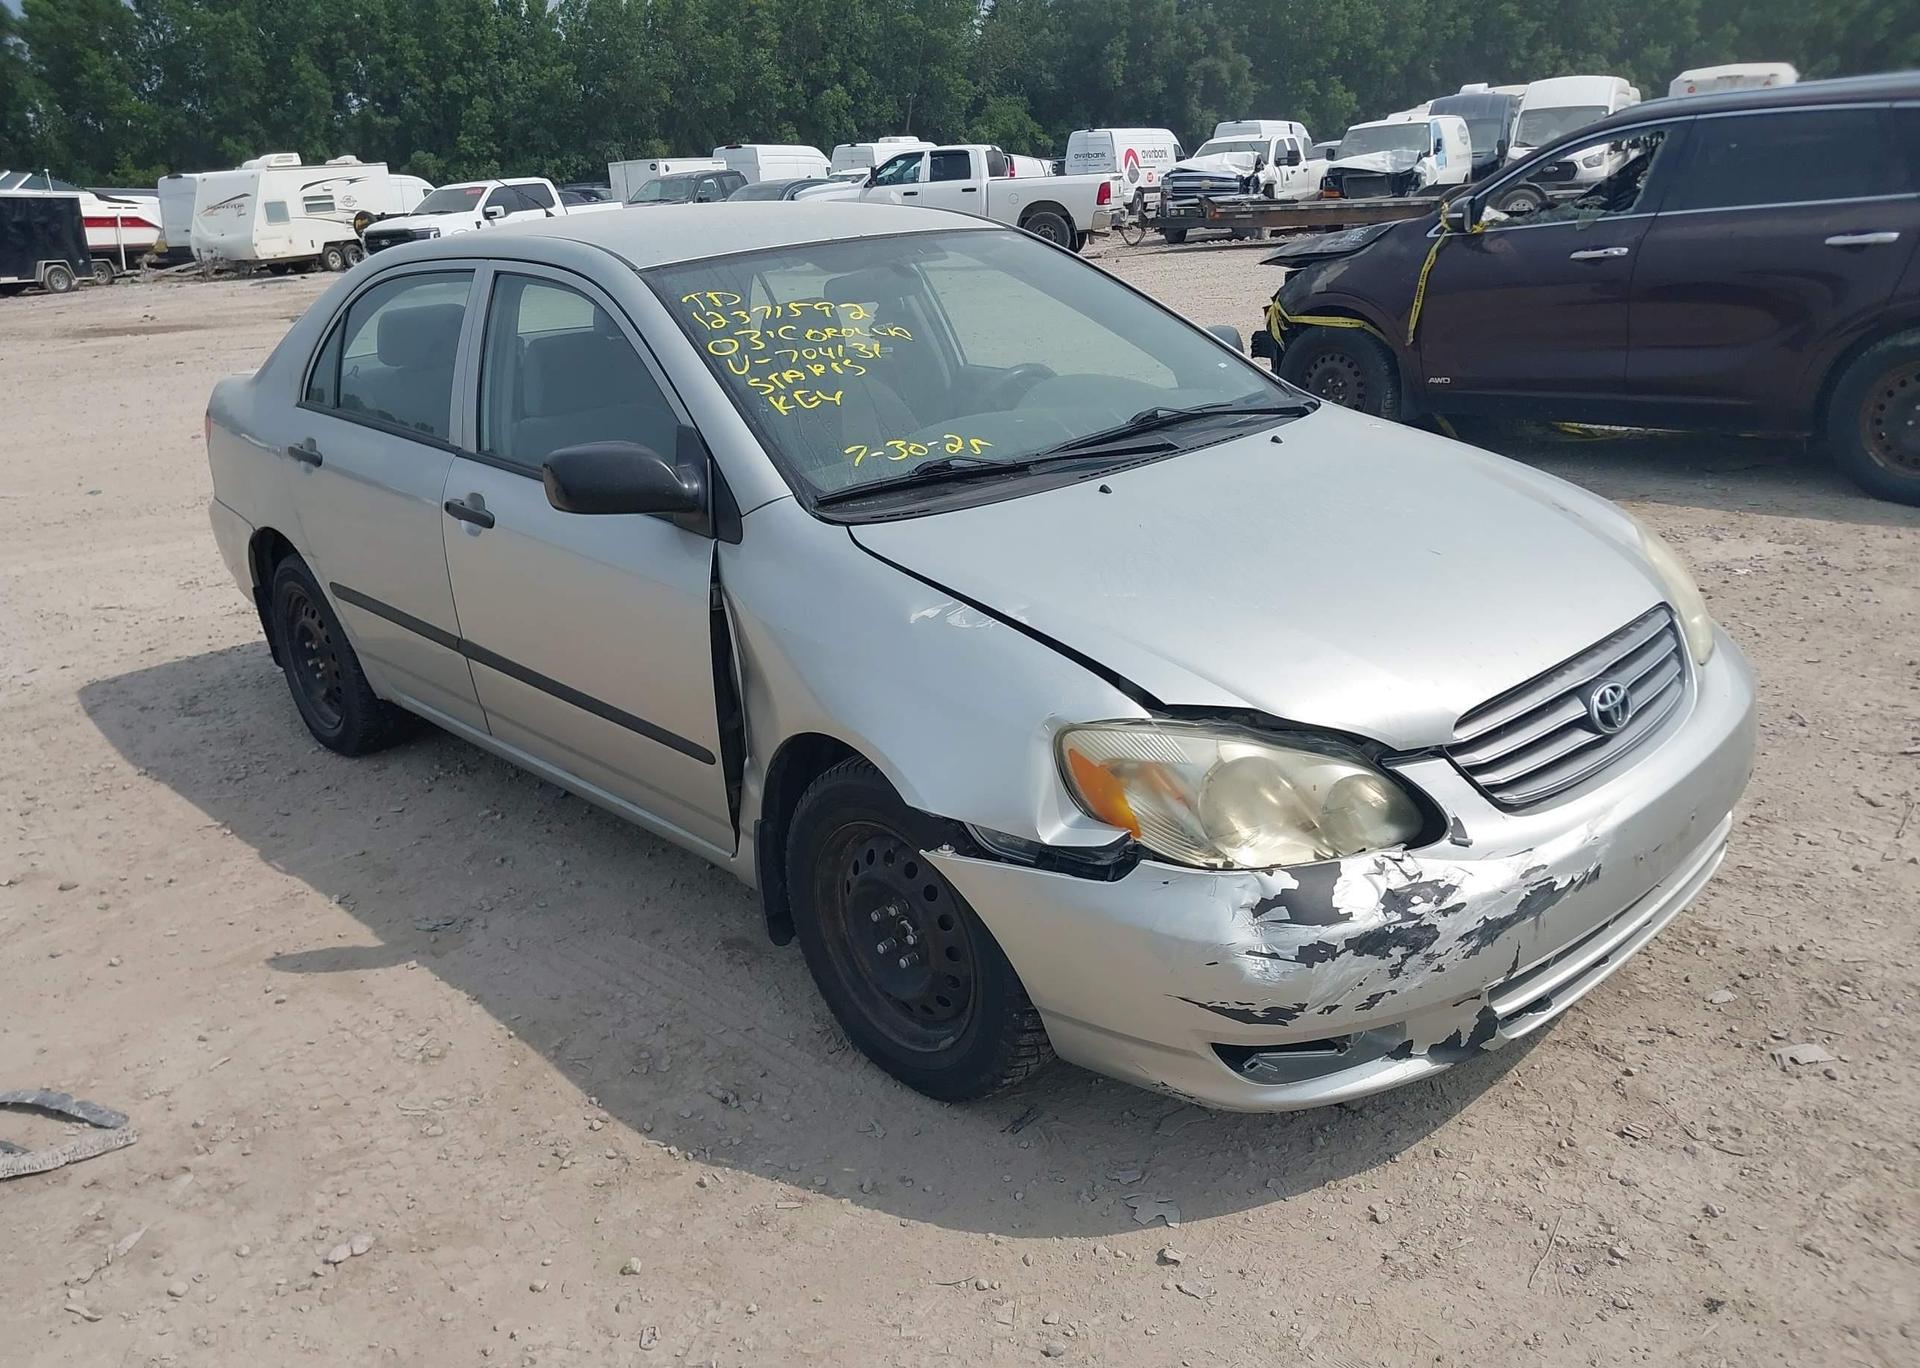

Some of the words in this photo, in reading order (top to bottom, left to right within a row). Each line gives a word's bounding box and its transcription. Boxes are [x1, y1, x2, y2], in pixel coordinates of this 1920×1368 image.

[681, 291, 742, 312] TD
[692, 301, 872, 330] 12371592
[768, 389, 844, 416] KEY
[843, 433, 993, 468] 7-30-25
